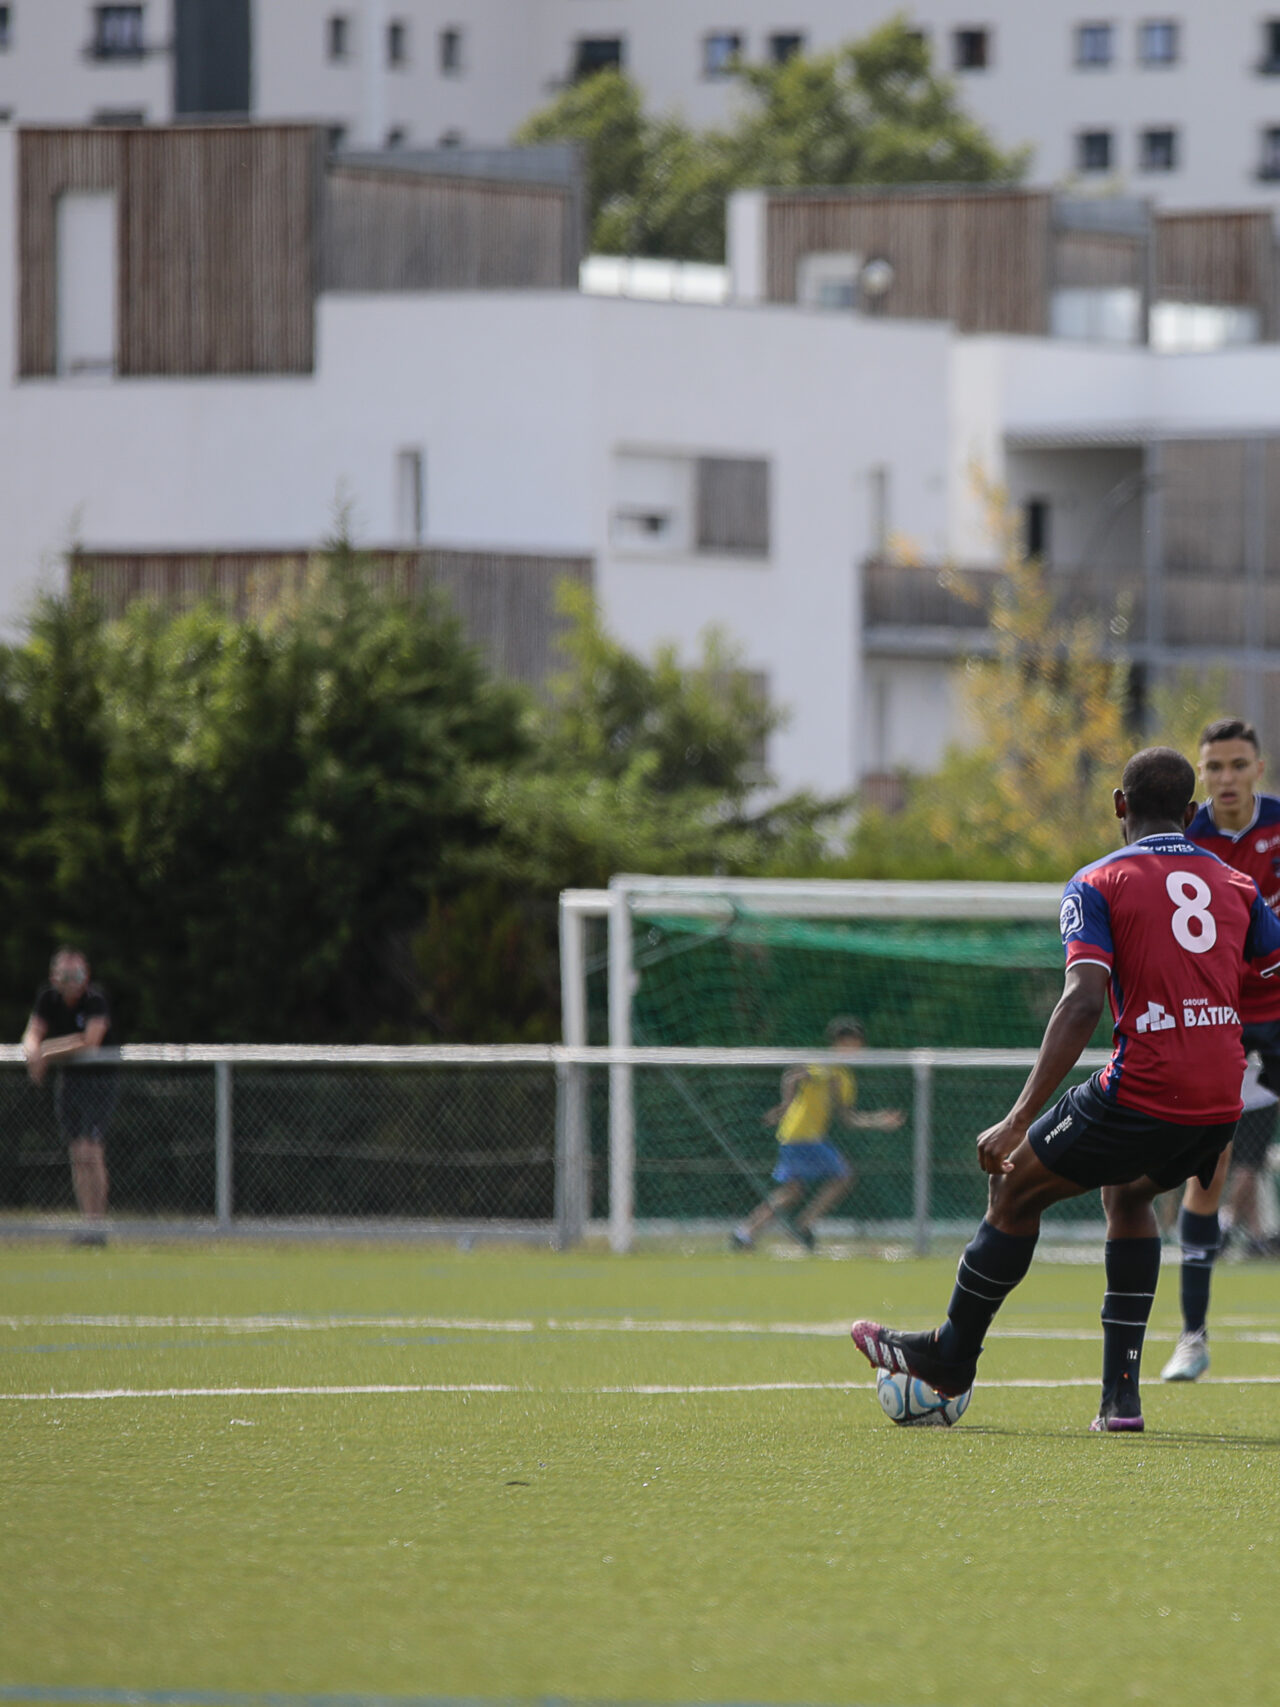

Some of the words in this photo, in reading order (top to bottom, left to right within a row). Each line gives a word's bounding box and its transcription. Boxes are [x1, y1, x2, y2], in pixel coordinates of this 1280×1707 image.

[1166, 870, 1217, 954] 8
[1182, 998, 1208, 1006] GROUPE
[1050, 1114, 1072, 1138] PATRICK
